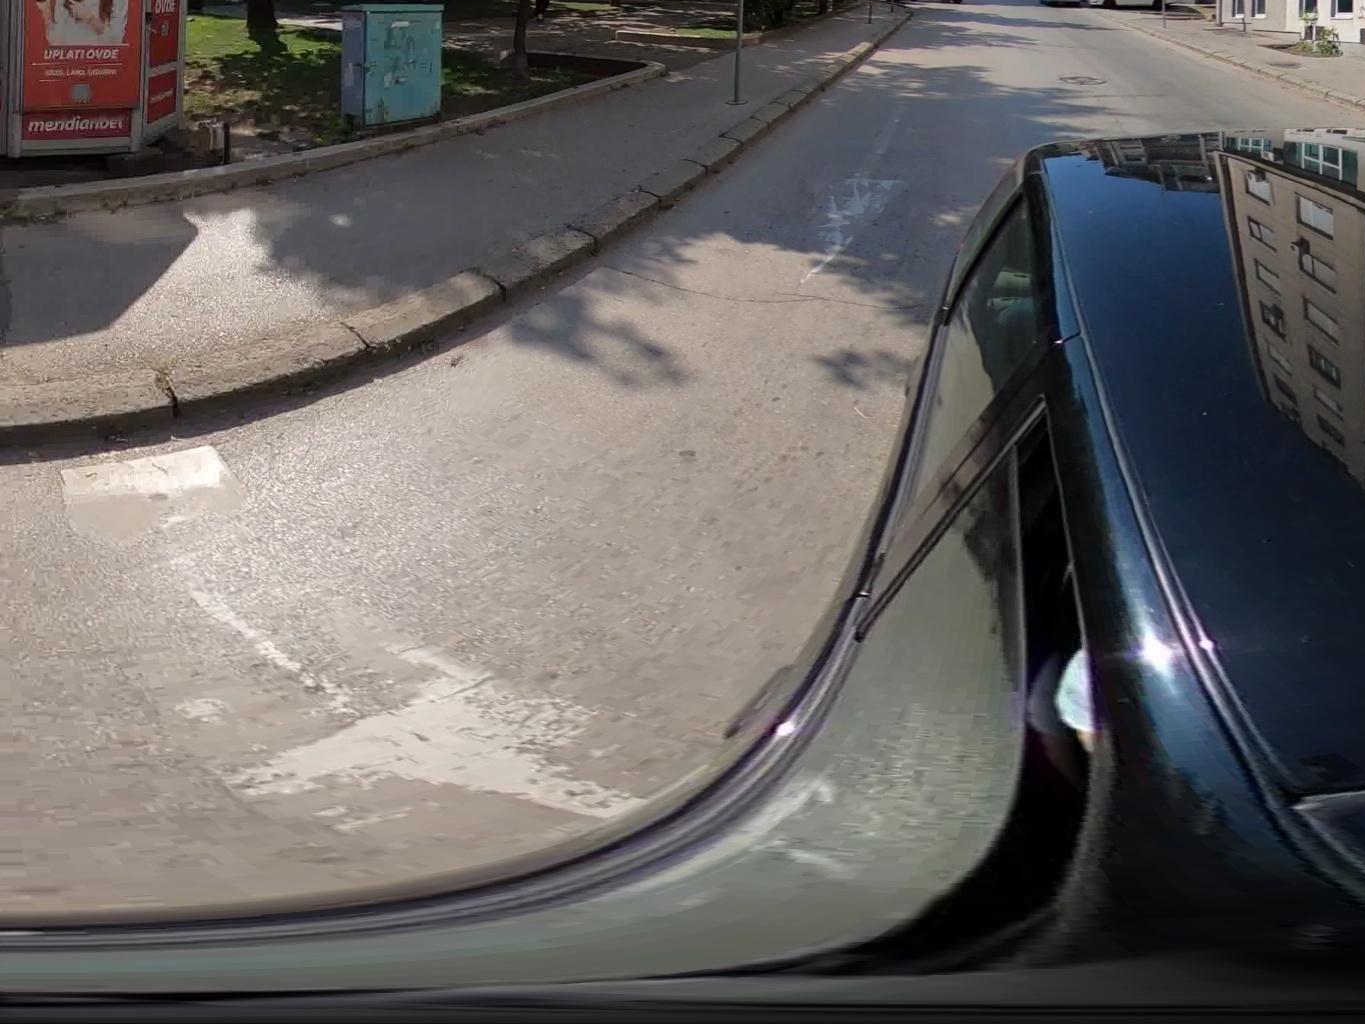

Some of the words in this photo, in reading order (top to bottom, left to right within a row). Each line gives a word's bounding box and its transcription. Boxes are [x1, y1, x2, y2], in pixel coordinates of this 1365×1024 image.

[43, 49, 84, 60] UPLATI
[86, 49, 120, 60] OVDE
[28, 115, 123, 132] meridianbet
